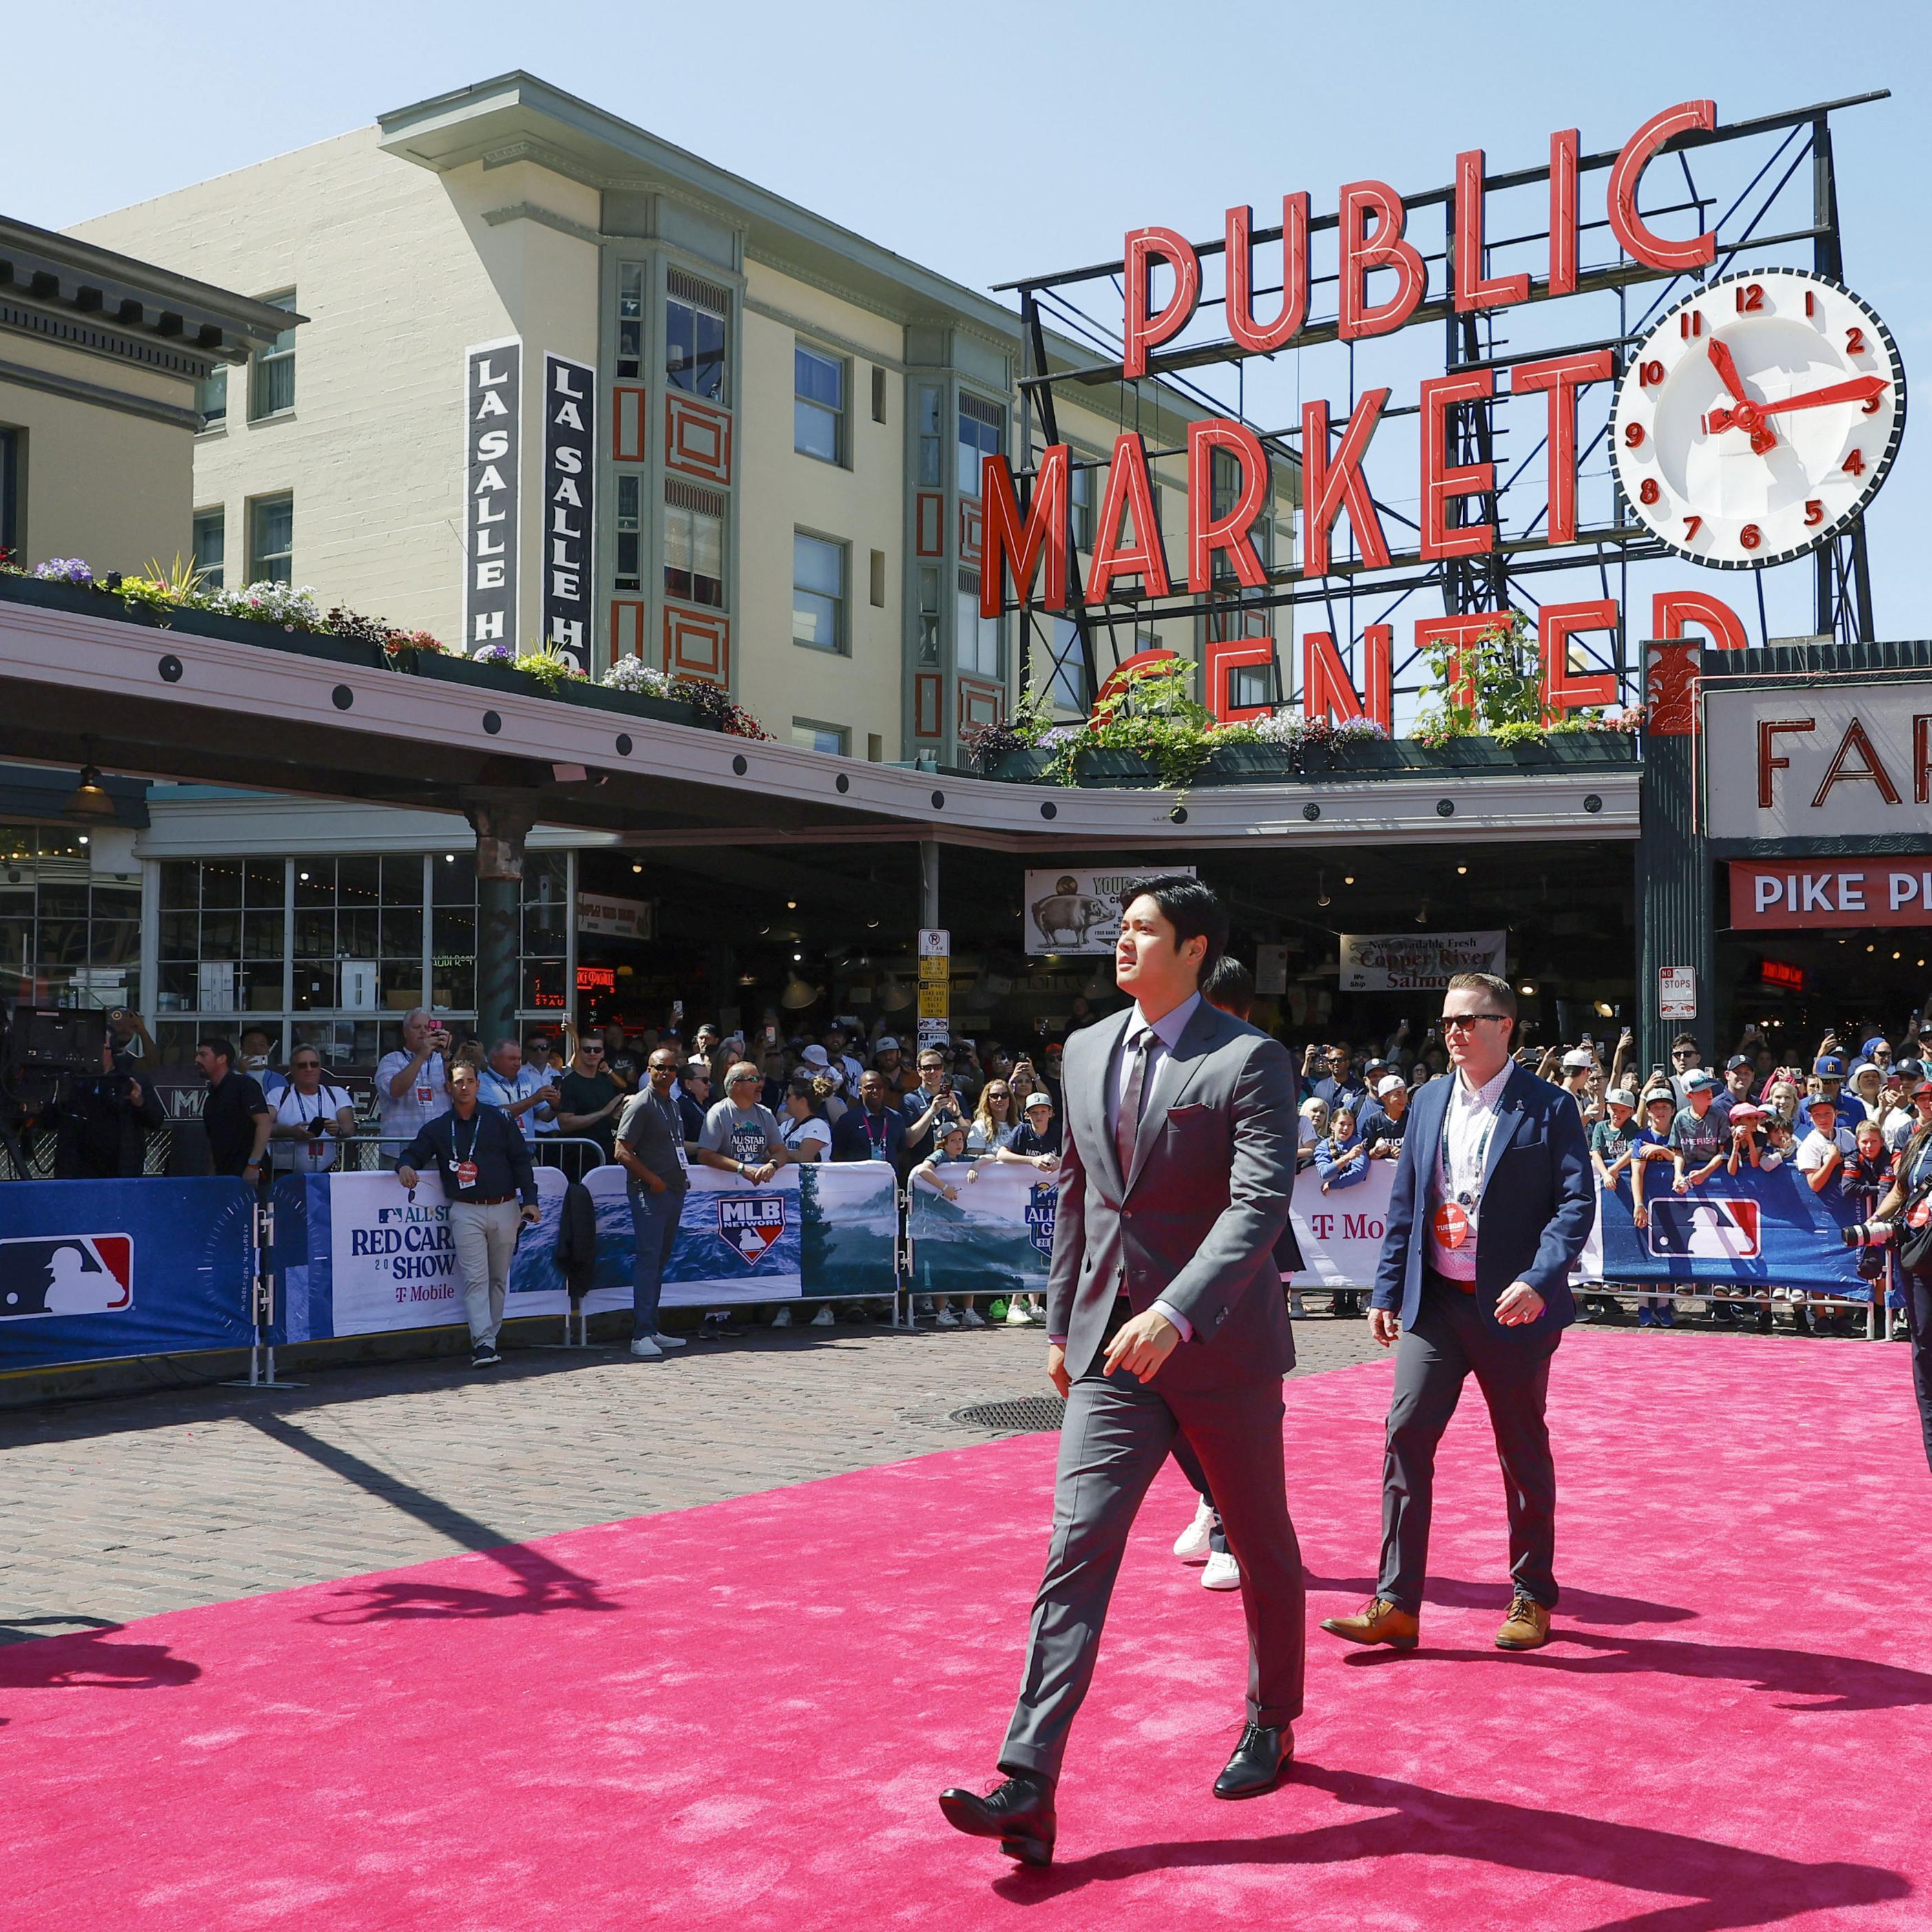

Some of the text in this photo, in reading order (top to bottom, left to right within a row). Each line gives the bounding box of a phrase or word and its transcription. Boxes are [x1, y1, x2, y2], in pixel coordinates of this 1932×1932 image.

[1124, 99, 1717, 378] PUBLIC
[1736, 283, 1764, 313] 12
[1805, 291, 1814, 317] 1
[1680, 311, 1701, 339] 11
[1846, 328, 1865, 355] 2
[1640, 360, 1665, 388] 10
[476, 359, 508, 420] LA
[554, 365, 584, 432] LA
[1625, 421, 1646, 449] 9
[1841, 450, 1867, 476] 4
[980, 350, 1615, 618] MARKET
[1640, 479, 1660, 506] 8
[474, 430, 510, 590] SALLE
[1804, 500, 1825, 526] 5
[552, 445, 583, 602] SALLE
[1683, 516, 1702, 542] 7
[1741, 524, 1762, 550] 6
[1754, 872, 1866, 912] PIKE
[1448, 937, 1476, 947] Fresh
[1438, 948, 1492, 965] River
[1387, 969, 1448, 989] Salmo
[1664, 980, 1691, 989] STOPS
[737, 1144, 758, 1153] GAME
[744, 1135, 764, 1144] STAR
[405, 1206, 433, 1223] ALL
[723, 1201, 781, 1221] MLB
[723, 1219, 783, 1228] NETWORK
[1436, 1221, 1465, 1232] TUESDAY
[352, 1226, 456, 1256] RED CAR
[410, 1283, 454, 1302] Mobile
